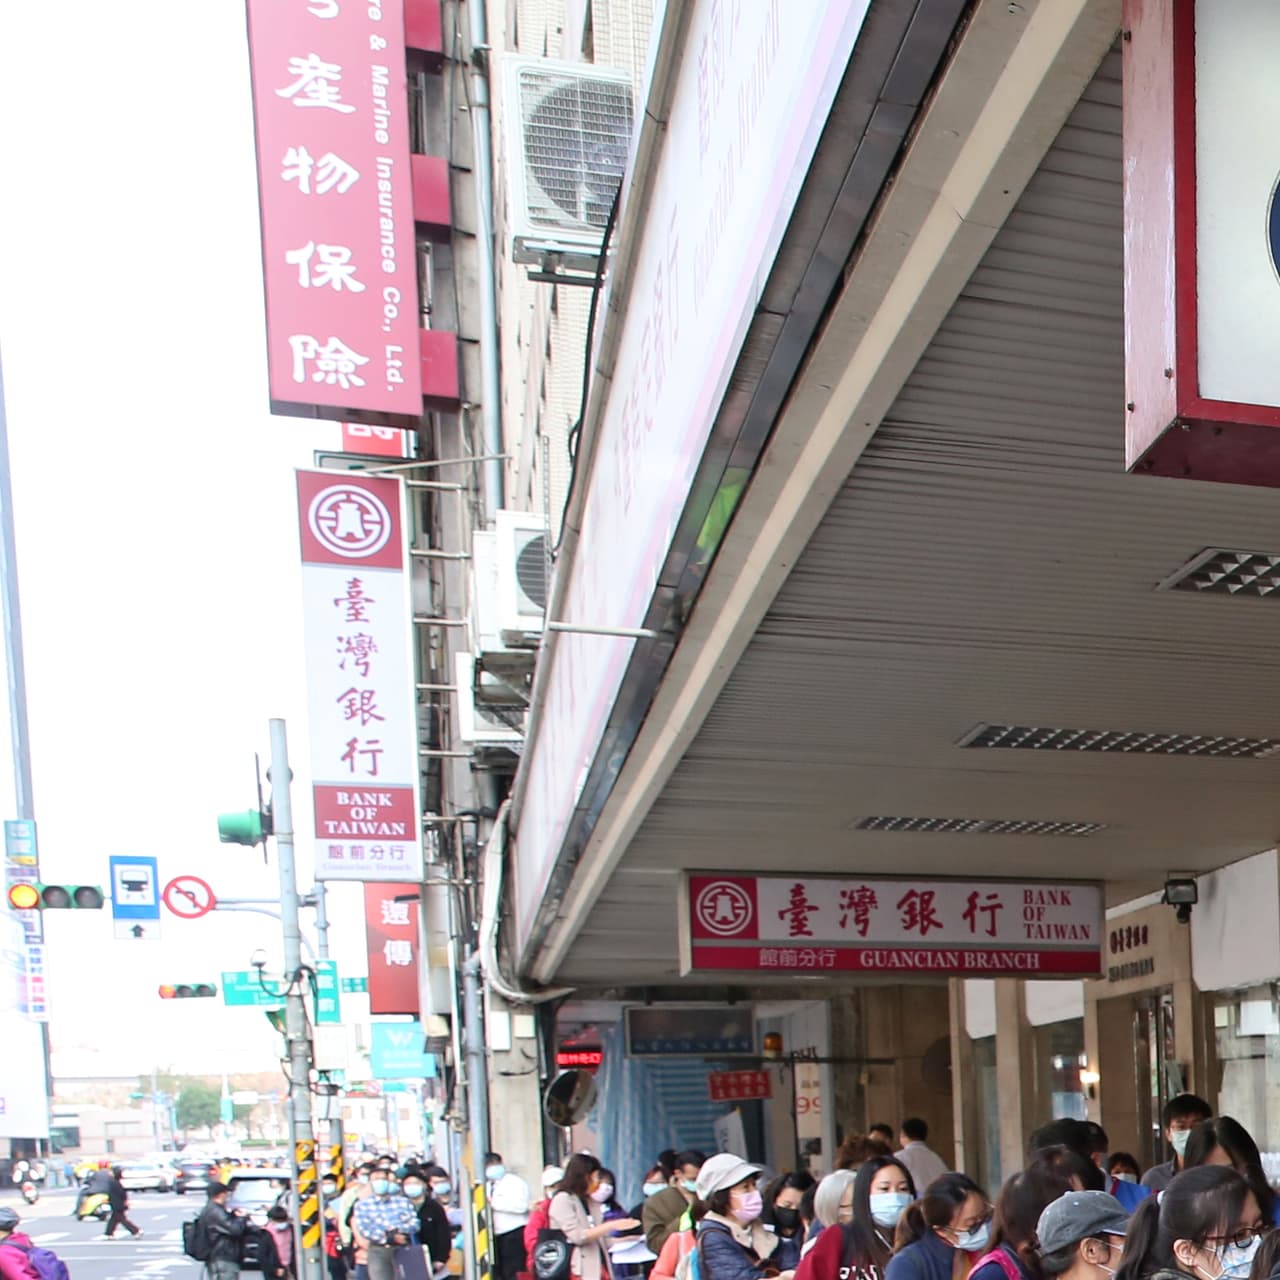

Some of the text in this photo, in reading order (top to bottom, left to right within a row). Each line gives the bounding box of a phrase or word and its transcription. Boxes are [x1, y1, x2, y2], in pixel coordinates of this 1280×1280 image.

[369, 34, 387, 51] &
[370, 65, 392, 145] Marine
[274, 0, 371, 389] 產物保險
[375, 156, 394, 274] Insurance
[382, 287, 401, 332] Co.,
[384, 345, 405, 391] Ltd.
[333, 576, 386, 776] 臺灣銀行
[336, 791, 393, 807] BANK
[349, 806, 378, 820] OF
[323, 820, 406, 836] TAIWAN
[1023, 888, 1073, 907] BANK
[777, 883, 1004, 938] 臺灣銀行
[1023, 905, 1047, 923] OF
[1023, 922, 1092, 942] TAIWAN
[758, 948, 839, 969] 館前分行
[859, 950, 1041, 971] GUANCIAN BRANCH
